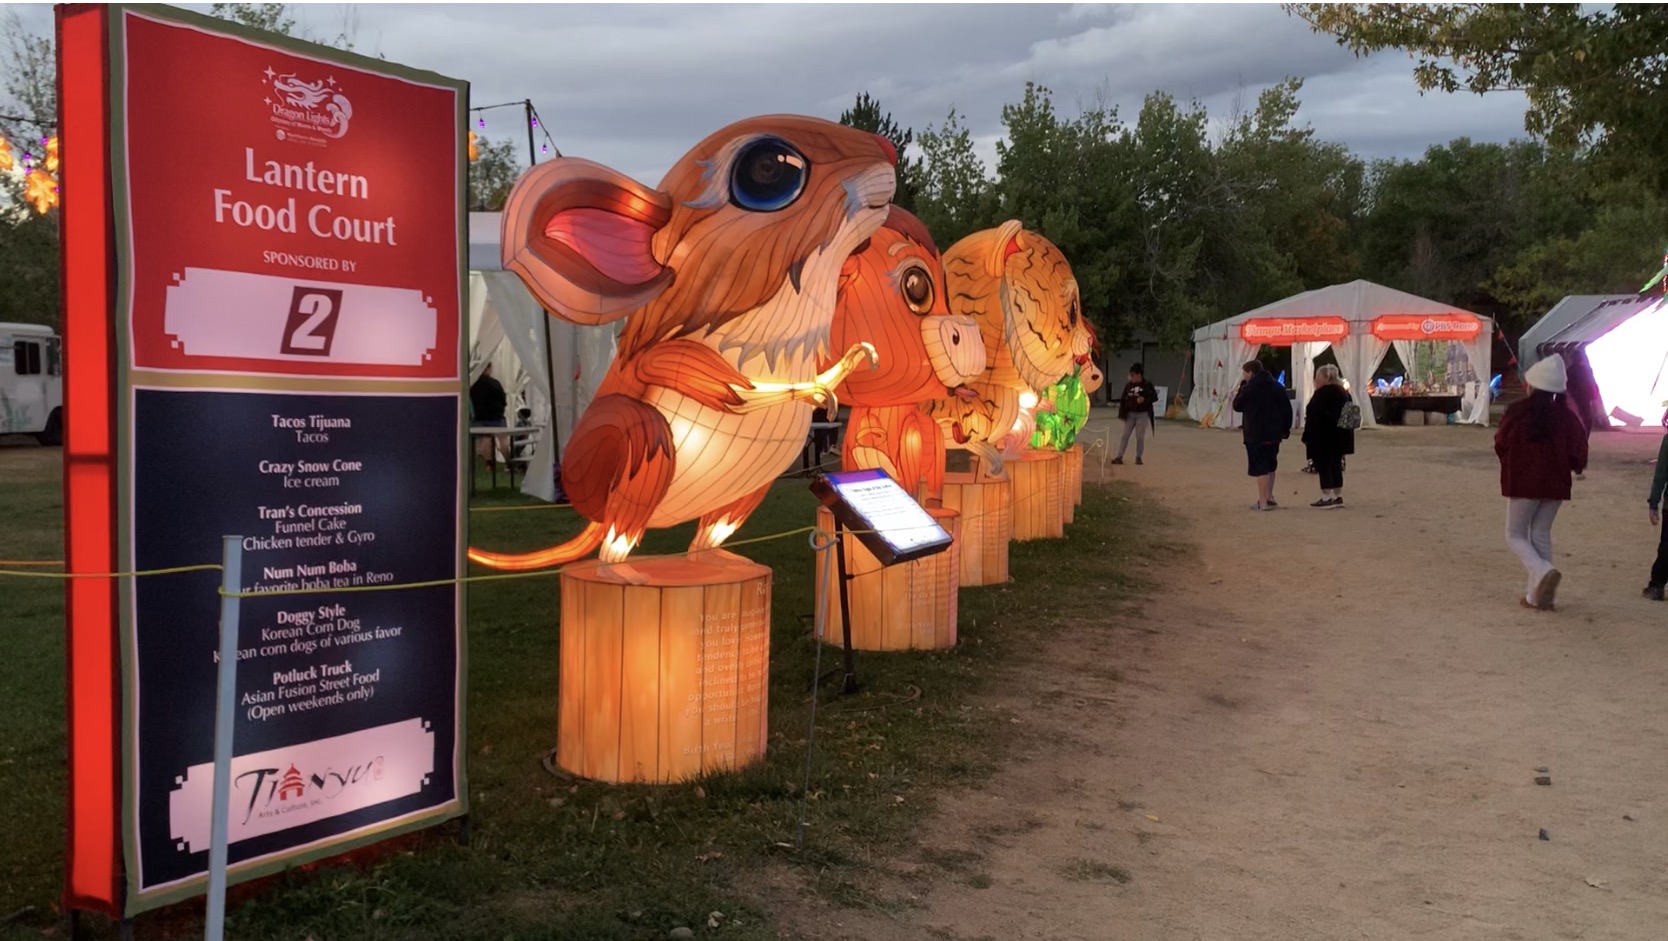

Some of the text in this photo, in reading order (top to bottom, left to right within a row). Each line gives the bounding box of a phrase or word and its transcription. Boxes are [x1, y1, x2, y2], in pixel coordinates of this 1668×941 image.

[273, 103, 305, 120] Dragon
[306, 110, 330, 126] Lights
[245, 147, 368, 199] Lantern
[214, 188, 397, 246] Food Court
[263, 250, 357, 272] SPONSORED BY
[290, 293, 333, 350] 2
[1435, 321, 1452, 331] PBS
[271, 414, 351, 431] Tacos Tijuana
[295, 430, 329, 443] Tacos
[258, 459, 362, 476] Crazy Snow Cone
[283, 475, 340, 488] Ice cream
[258, 501, 362, 519] Tran's Concession
[275, 516, 347, 534] Funnel Cake
[243, 530, 375, 551] Chicken tender & Gyro
[263, 559, 357, 580] Num Num Boba
[254, 580, 299, 593] favorite
[301, 577, 331, 590] boba
[333, 577, 350, 588] tea
[352, 573, 364, 585] in
[366, 571, 394, 583] Reno
[277, 603, 347, 626] Doggy Style
[261, 618, 361, 642] Korean Corn Dog
[213, 625, 402, 664] Kean corn dogs of various favor
[272, 659, 352, 685] Potluck Truck
[241, 668, 380, 706] Asian Fusion Street Food
[247, 686, 374, 721] (Open weekends only)
